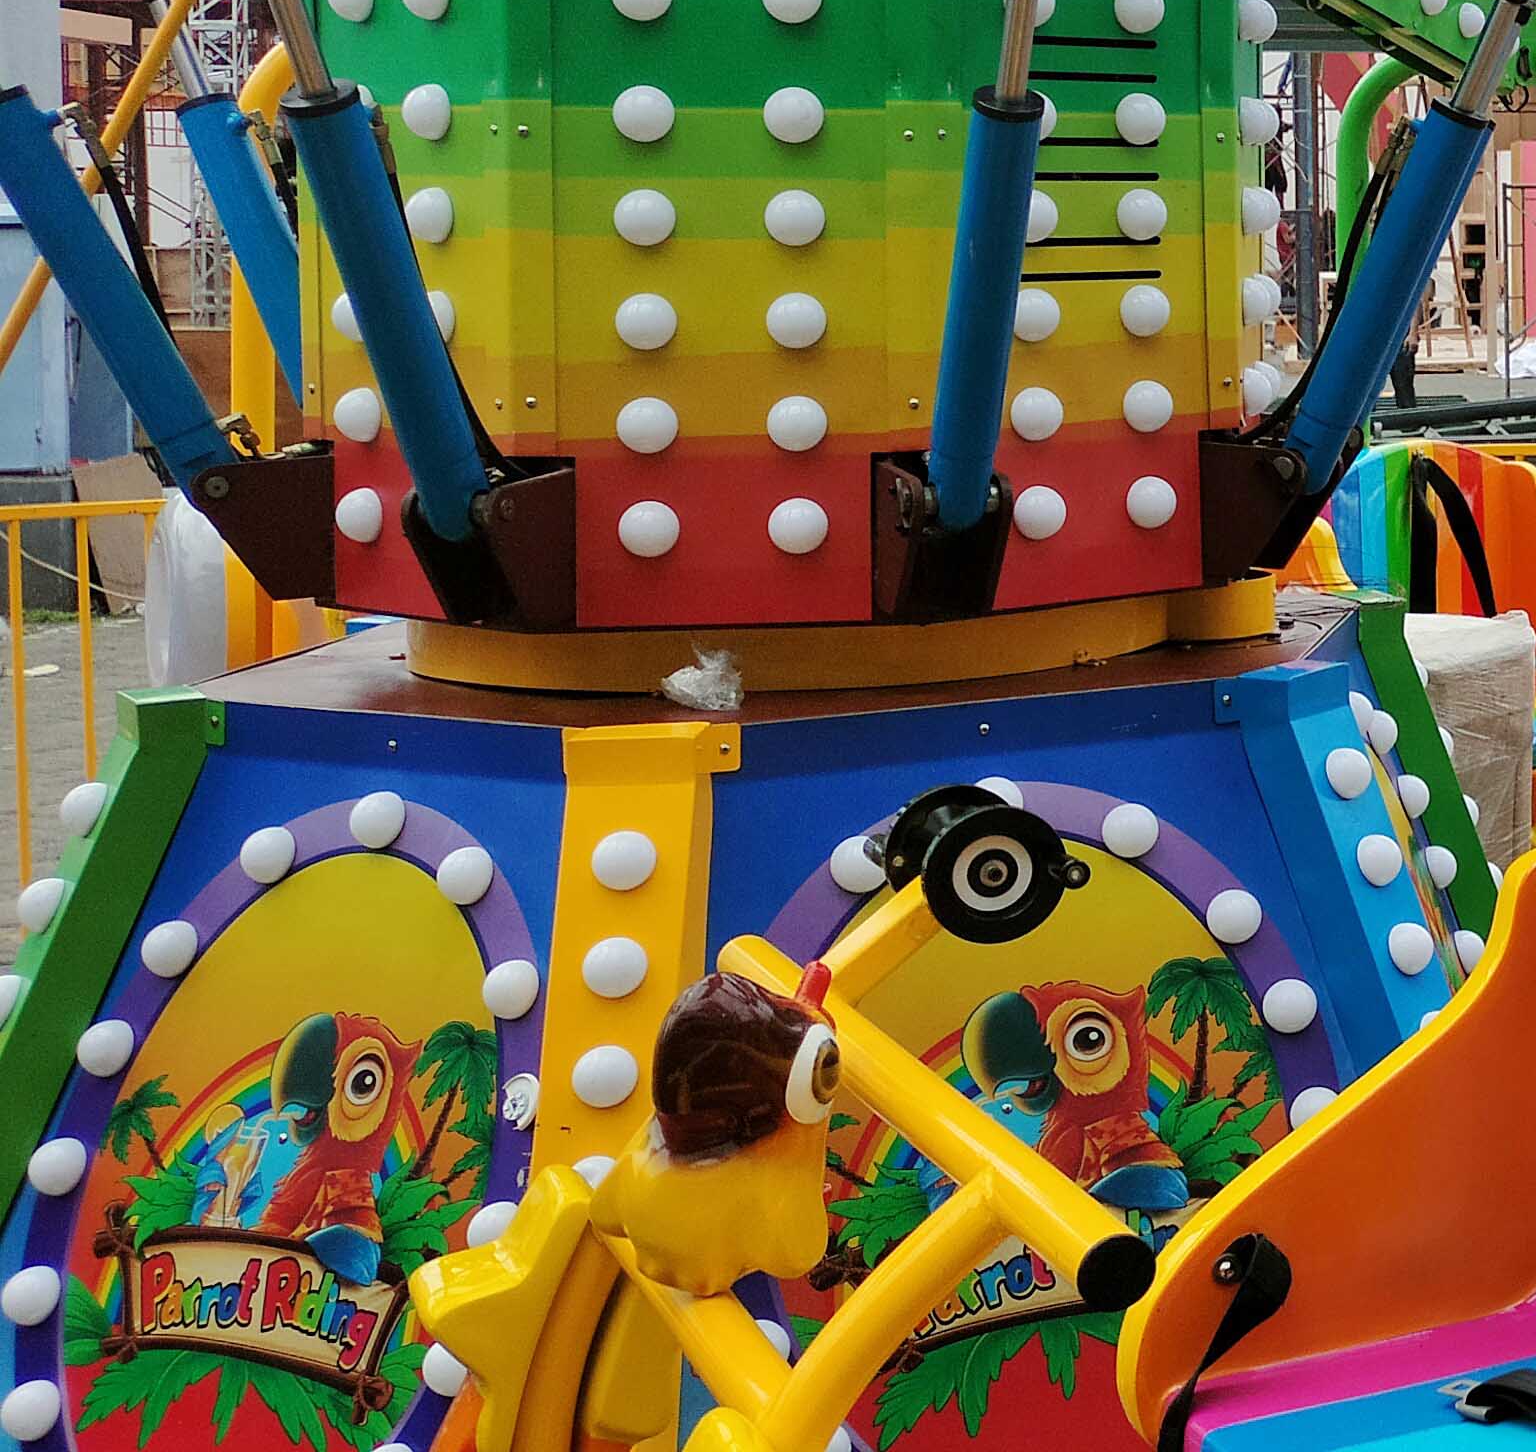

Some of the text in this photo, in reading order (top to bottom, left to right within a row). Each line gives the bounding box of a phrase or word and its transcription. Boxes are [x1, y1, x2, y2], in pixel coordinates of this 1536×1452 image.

[140, 1251, 379, 1371] Parrot Riding
[913, 1244, 1056, 1338] arrot
